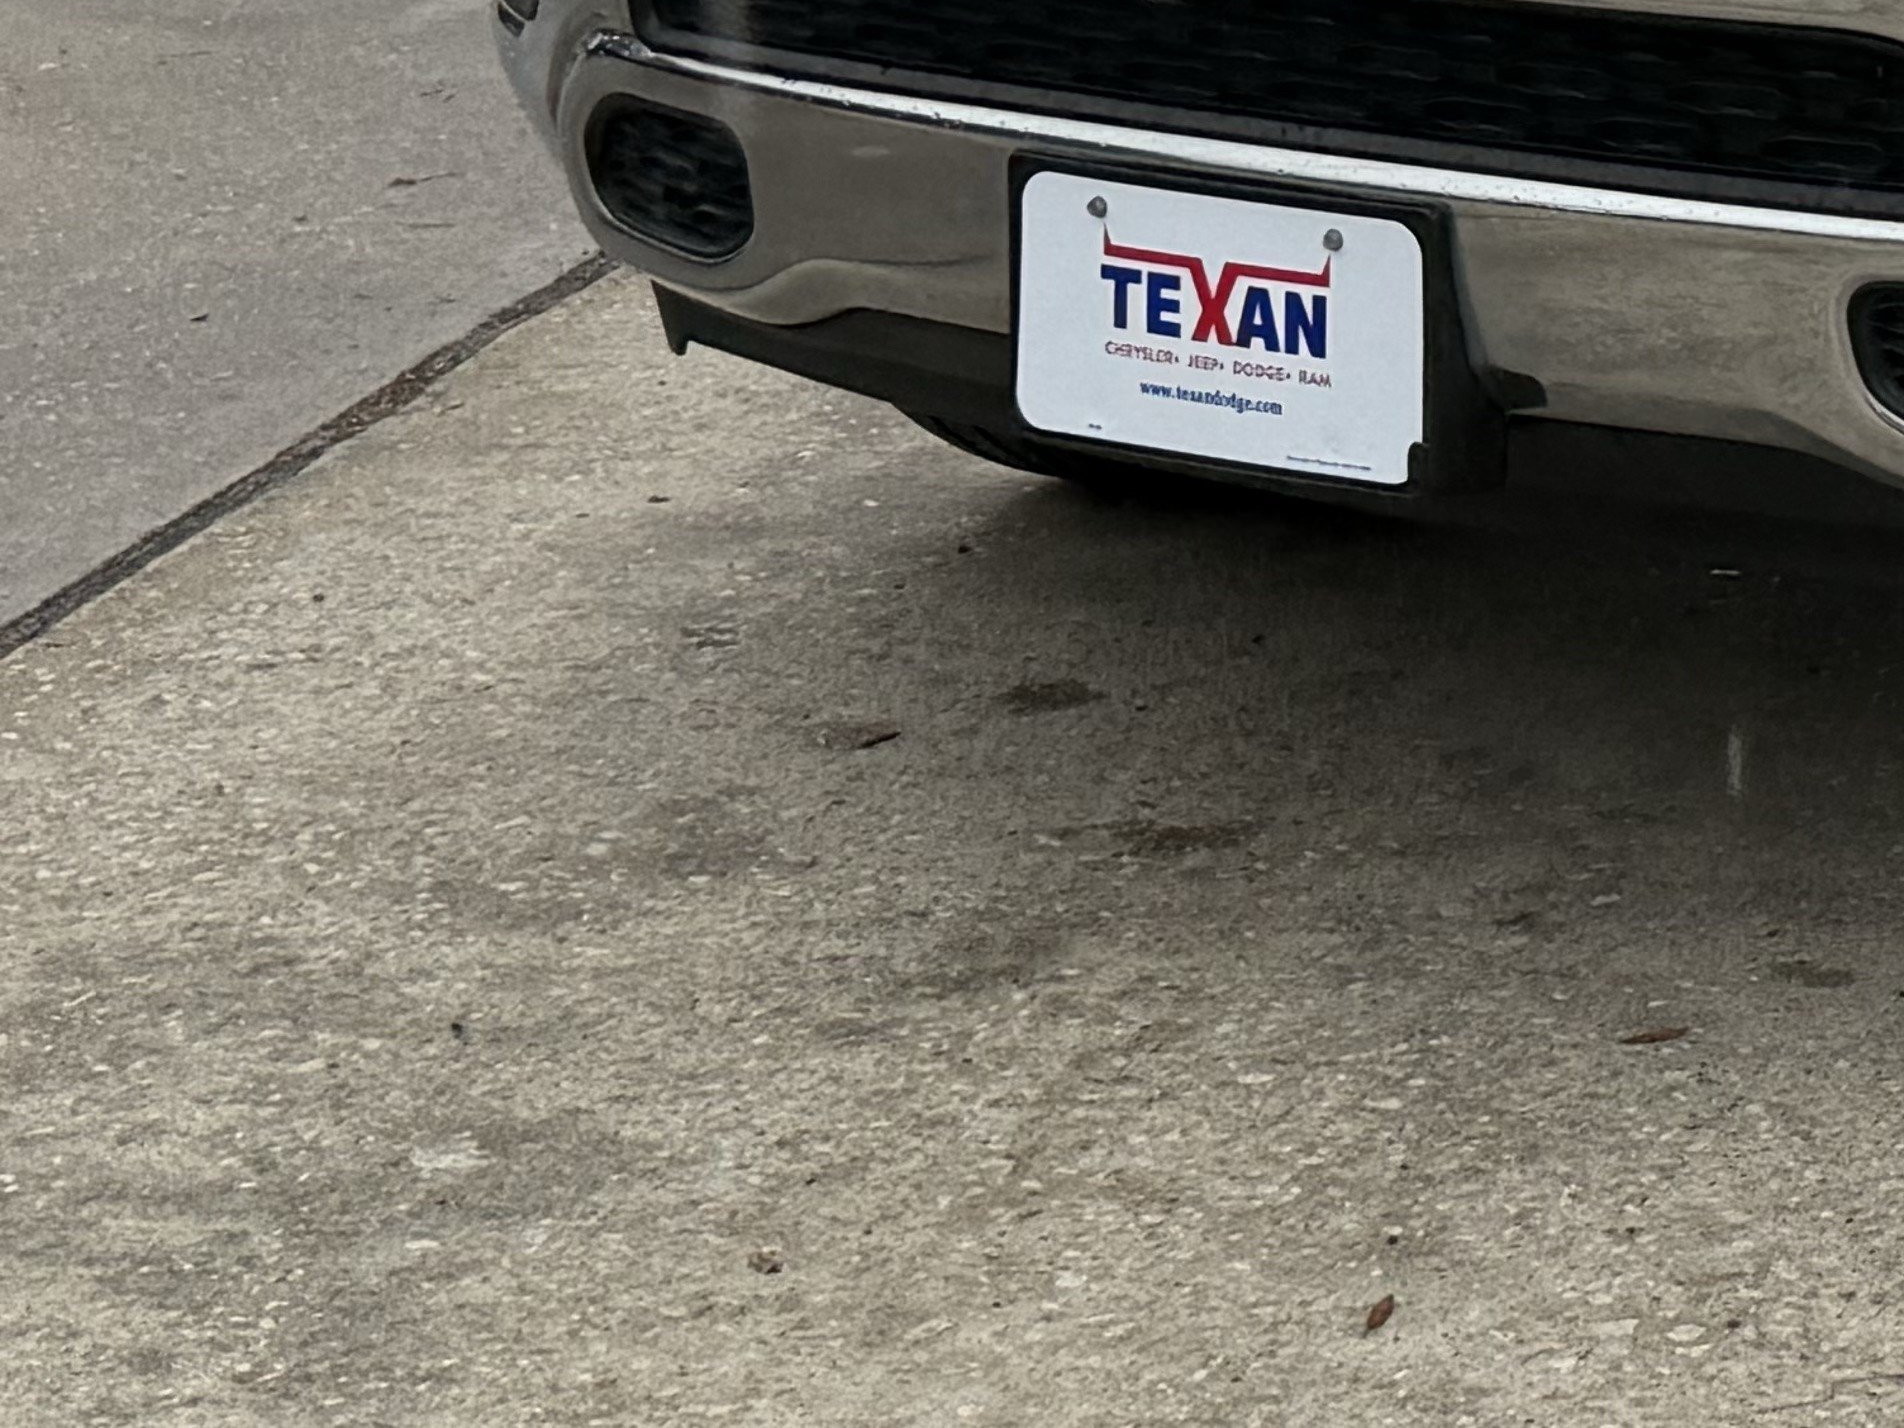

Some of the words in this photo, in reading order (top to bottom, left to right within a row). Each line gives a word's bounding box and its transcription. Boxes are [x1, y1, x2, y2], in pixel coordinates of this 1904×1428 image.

[1100, 244, 1329, 360] TEXAN
[1298, 368, 1333, 389] RAM
[1139, 380, 1284, 416] www.texandodge.com
